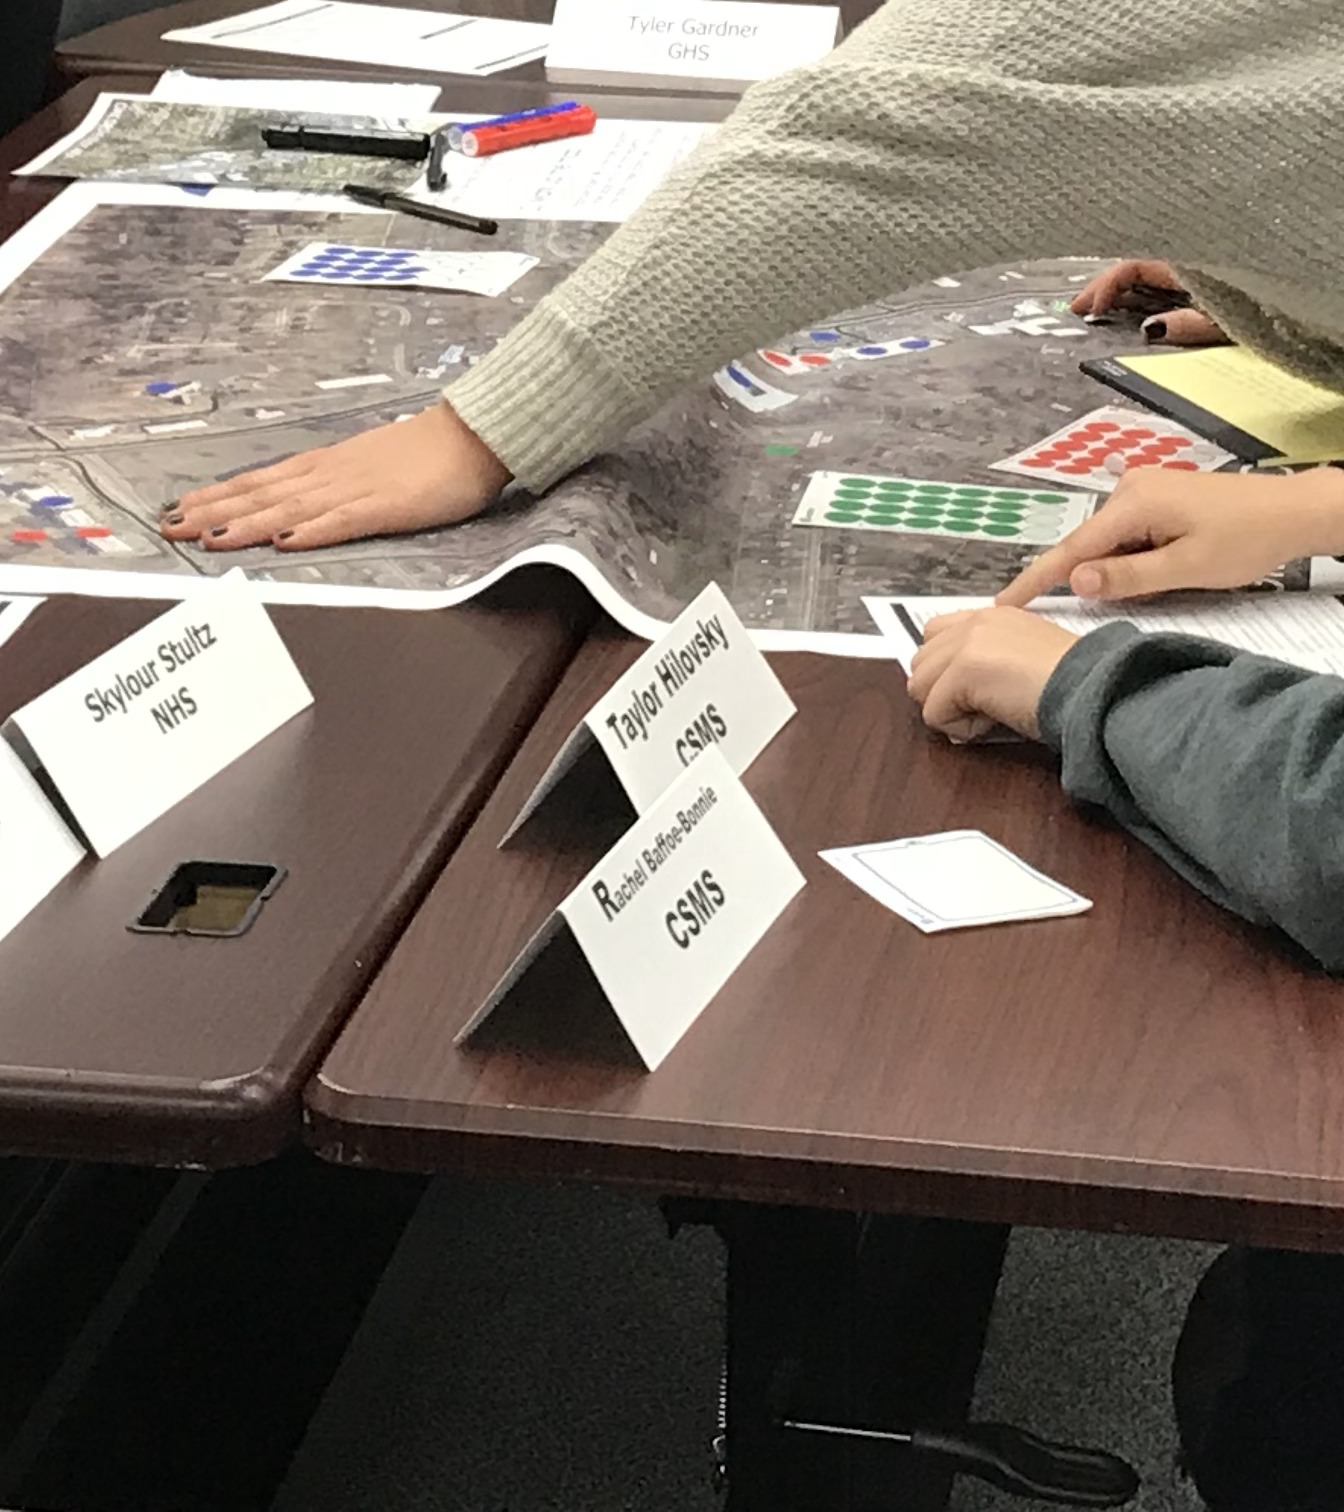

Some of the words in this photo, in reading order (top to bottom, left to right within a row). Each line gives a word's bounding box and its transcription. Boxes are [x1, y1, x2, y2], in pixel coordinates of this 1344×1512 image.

[628, 15, 675, 35] Tyler
[681, 18, 759, 39] Gardner
[668, 42, 710, 61] GHS
[84, 659, 160, 723] Skylour
[157, 622, 218, 673] Stultz
[151, 686, 199, 735] NHS
[605, 681, 664, 750] Taylor
[654, 613, 729, 698] Hilovsky
[591, 859, 648, 922] Rachel
[642, 786, 718, 874] Baffoe-Bonnie
[664, 869, 726, 950] CSMS
